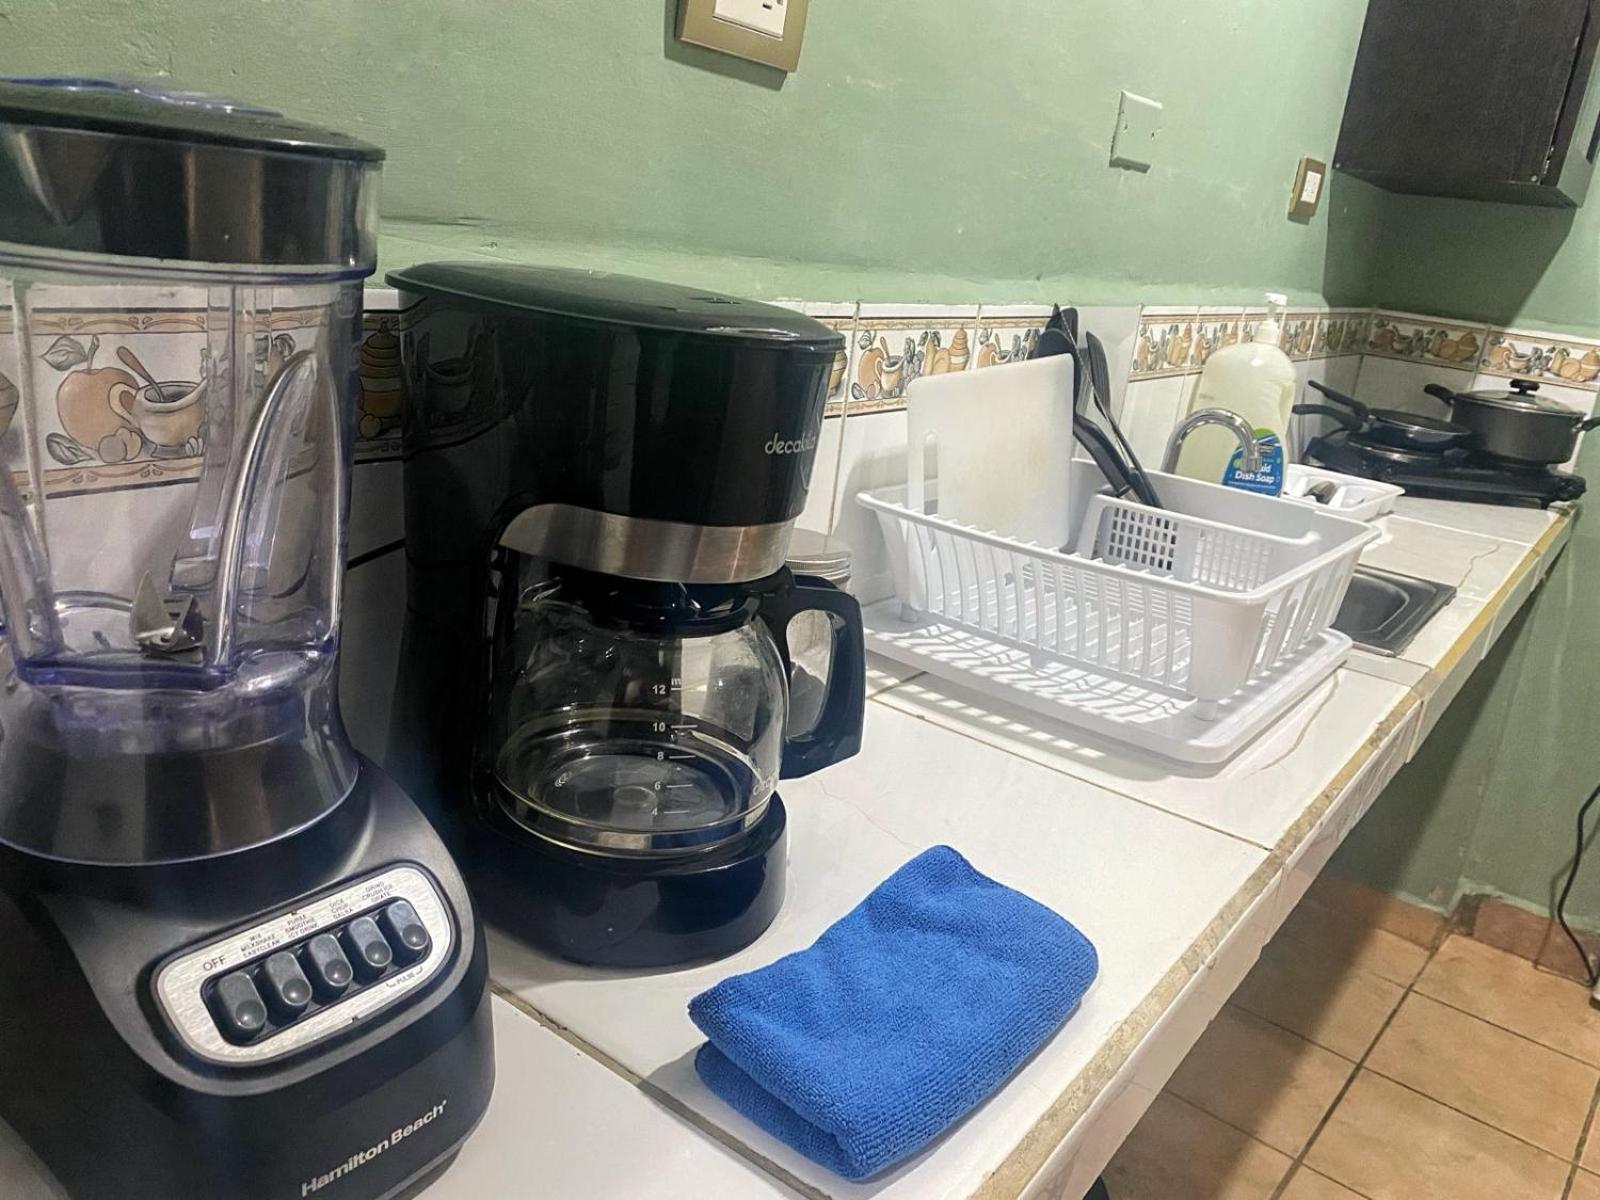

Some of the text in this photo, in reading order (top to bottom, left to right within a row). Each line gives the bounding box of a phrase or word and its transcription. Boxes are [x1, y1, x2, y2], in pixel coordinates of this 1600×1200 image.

[764, 432, 817, 455] deca
[1235, 471, 1255, 480] Dish
[1256, 473, 1275, 485] Soap
[652, 684, 666, 695] 12
[652, 722, 666, 732] 10
[656, 751, 664, 760] 8
[654, 782, 662, 790] 6
[651, 807, 659, 816] 4
[203, 956, 226, 971] OFF
[301, 1139, 389, 1198] Hamilton
